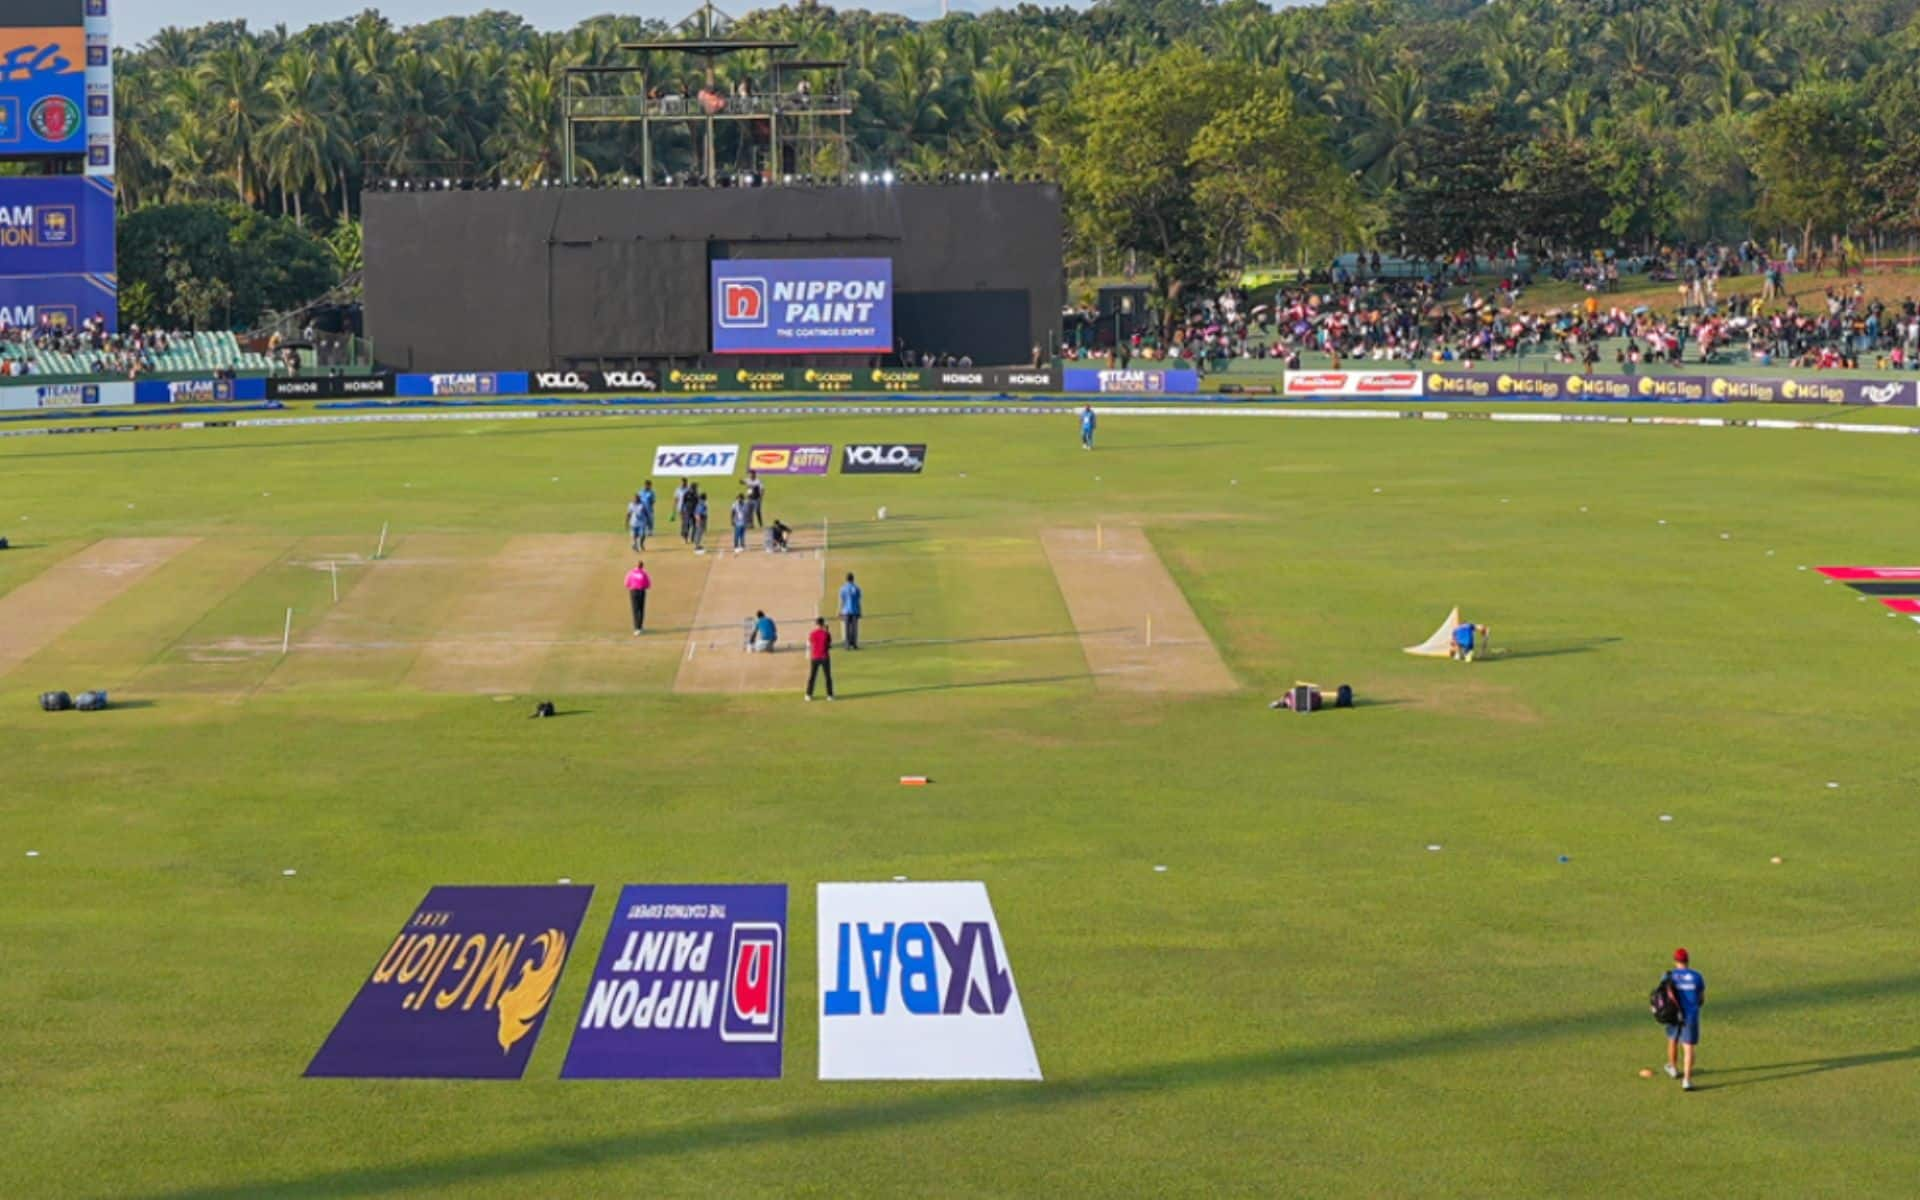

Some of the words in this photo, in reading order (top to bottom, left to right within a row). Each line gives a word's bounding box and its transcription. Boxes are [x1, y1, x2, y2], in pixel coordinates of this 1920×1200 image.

[773, 281, 885, 301] NIPPON
[784, 303, 874, 323] PAINT
[777, 328, 793, 337] THE
[841, 328, 876, 337] EXPERT
[277, 383, 318, 394] HONOR
[344, 380, 384, 391] HONOR
[943, 373, 983, 384] HONOR
[1008, 374, 1050, 385] HONOR
[657, 452, 735, 467] 1XBAT
[612, 931, 715, 972] PAINT
[823, 921, 1013, 1016] 1XBAT
[580, 978, 720, 1029] NIPPON
